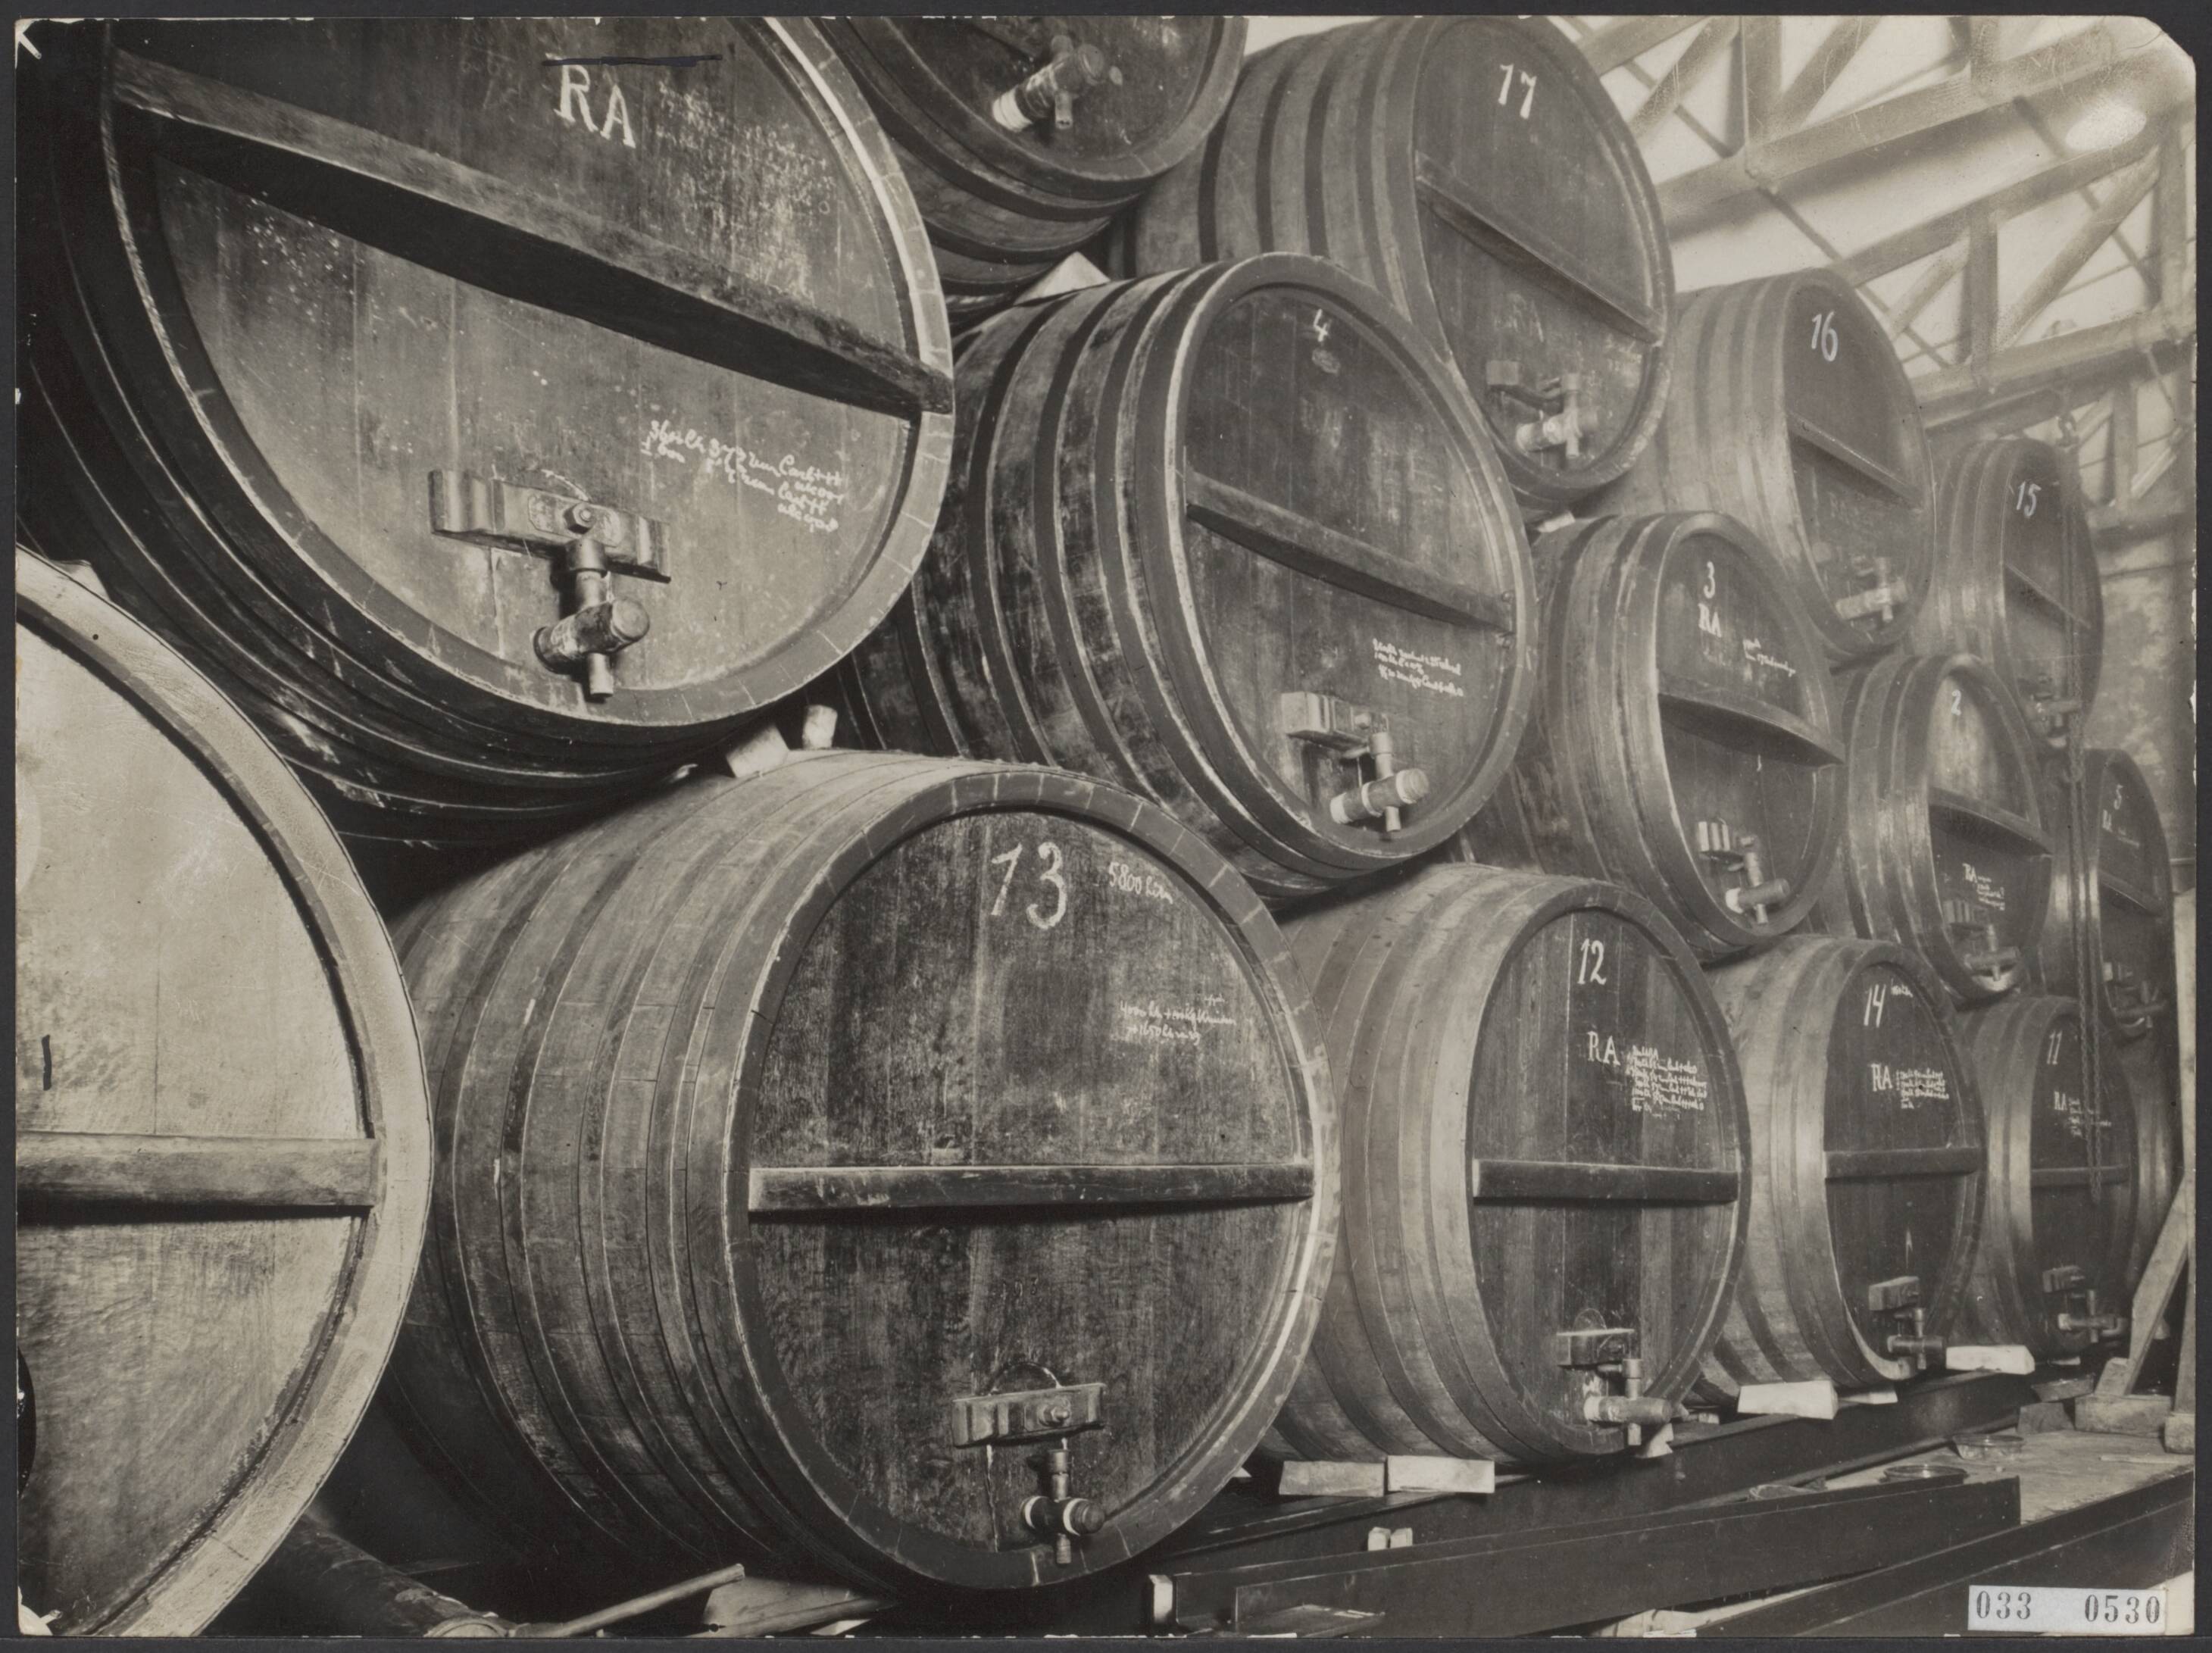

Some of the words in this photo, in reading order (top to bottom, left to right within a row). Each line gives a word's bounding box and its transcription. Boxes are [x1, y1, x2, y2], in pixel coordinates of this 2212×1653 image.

[554, 64, 636, 148] RA
[1498, 64, 1537, 119] 17
[1313, 308, 1329, 342] 4
[1811, 311, 1839, 361] 16
[2016, 481, 2042, 517] 15
[1703, 561, 1716, 598] 3
[1698, 603, 1722, 638] RA
[1951, 689, 1961, 716] 2
[2114, 783, 2123, 811] 5
[990, 841, 1067, 930] 13
[1108, 861, 1142, 895] 5800
[1962, 863, 1978, 883] RA
[1577, 938, 1607, 985] 12
[1864, 984, 1886, 1028] 14
[1587, 1031, 1621, 1066] RA
[2046, 1031, 2063, 1064] 11
[1871, 1063, 1893, 1092] RA
